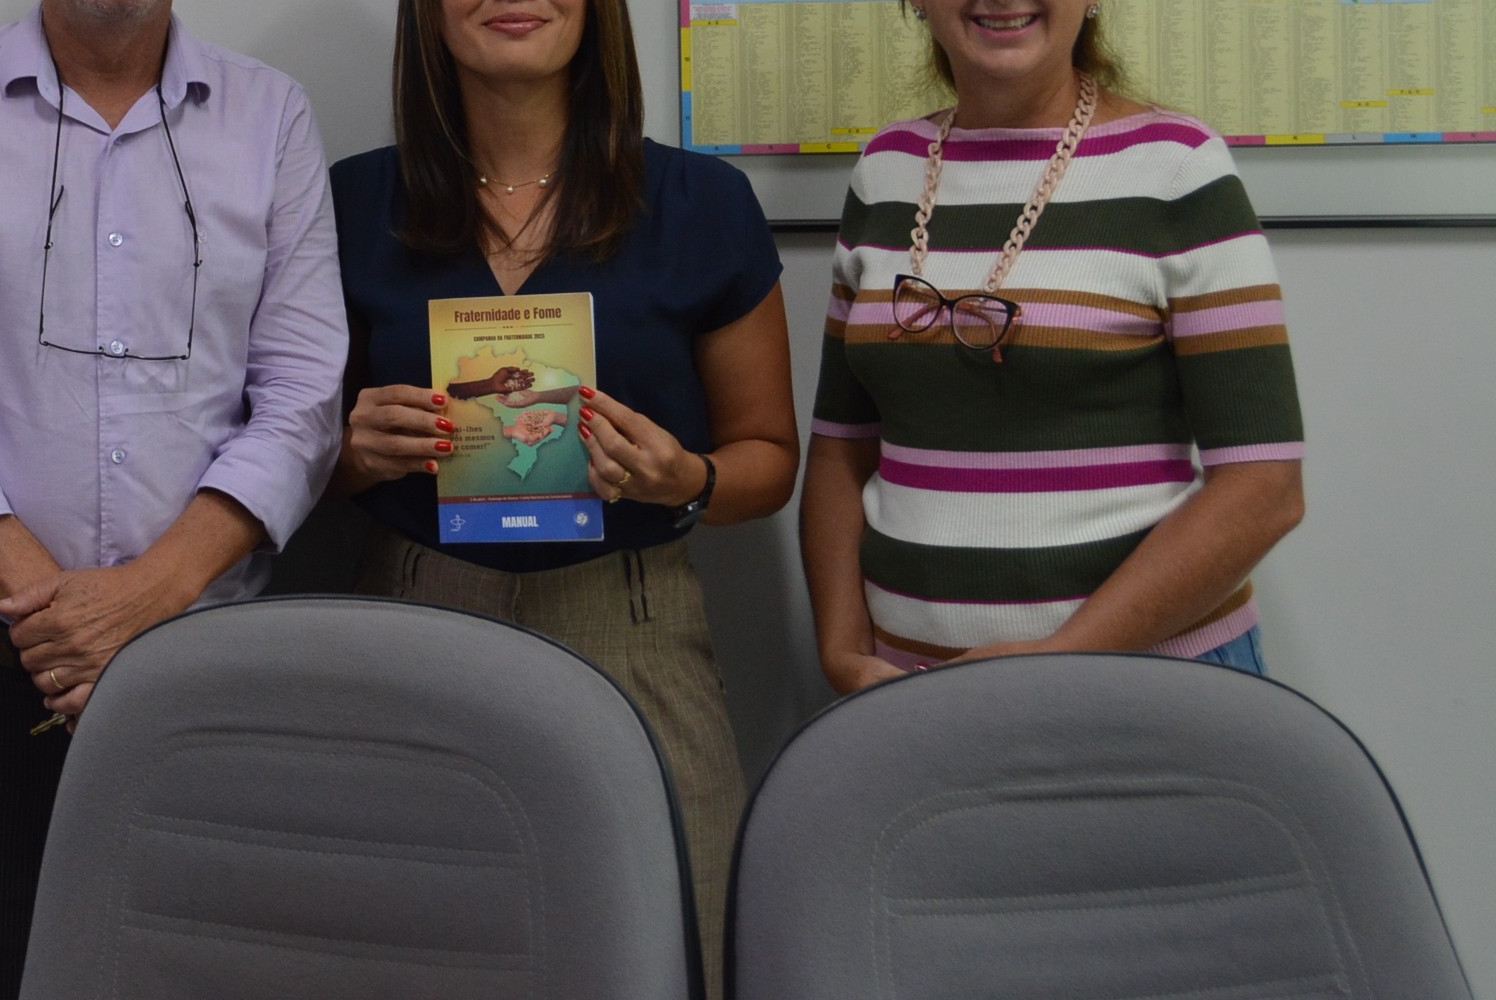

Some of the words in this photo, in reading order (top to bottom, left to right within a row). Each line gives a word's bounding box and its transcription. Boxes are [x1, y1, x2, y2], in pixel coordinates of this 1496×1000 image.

[454, 308, 521, 323] Fraternidade
[524, 311, 530, 320] e
[533, 307, 562, 319] Fome
[501, 516, 539, 528] MANUAL
